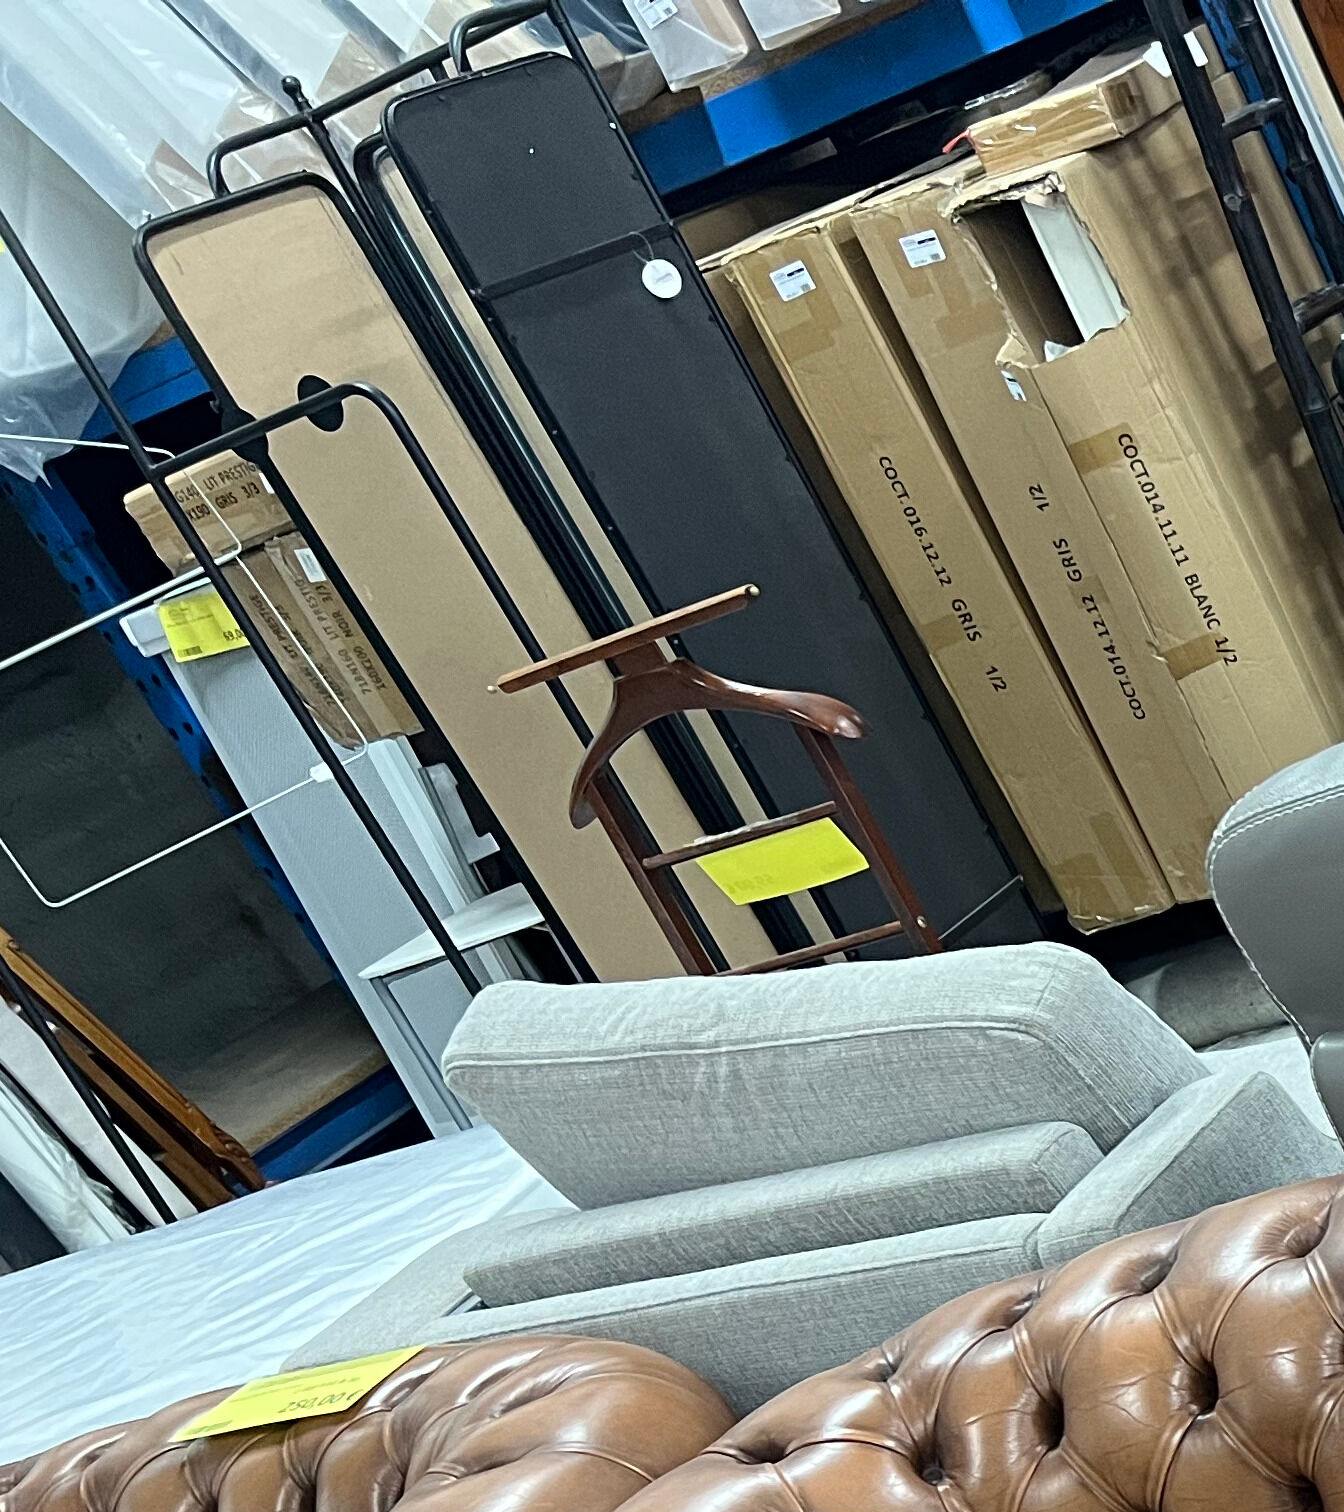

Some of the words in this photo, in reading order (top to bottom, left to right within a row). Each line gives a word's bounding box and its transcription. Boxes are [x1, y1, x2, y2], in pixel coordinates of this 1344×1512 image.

[218, 461, 257, 485] PRESTIG
[214, 491, 239, 509] GRIS
[240, 481, 260, 499] 3/3
[1029, 483, 1050, 512] 1/2
[1052, 538, 1082, 582] GRIS
[1118, 433, 1190, 567] COCT.014.11.11
[1184, 573, 1221, 630] BLANC
[1214, 636, 1238, 667] 1/2
[294, 578, 328, 622] PRESTIG
[322, 626, 341, 641] LIT
[331, 610, 354, 639] NOIR
[951, 598, 983, 642] GRIS
[985, 665, 1007, 693] 1/2
[1081, 594, 1146, 720] COCT.014.12.12
